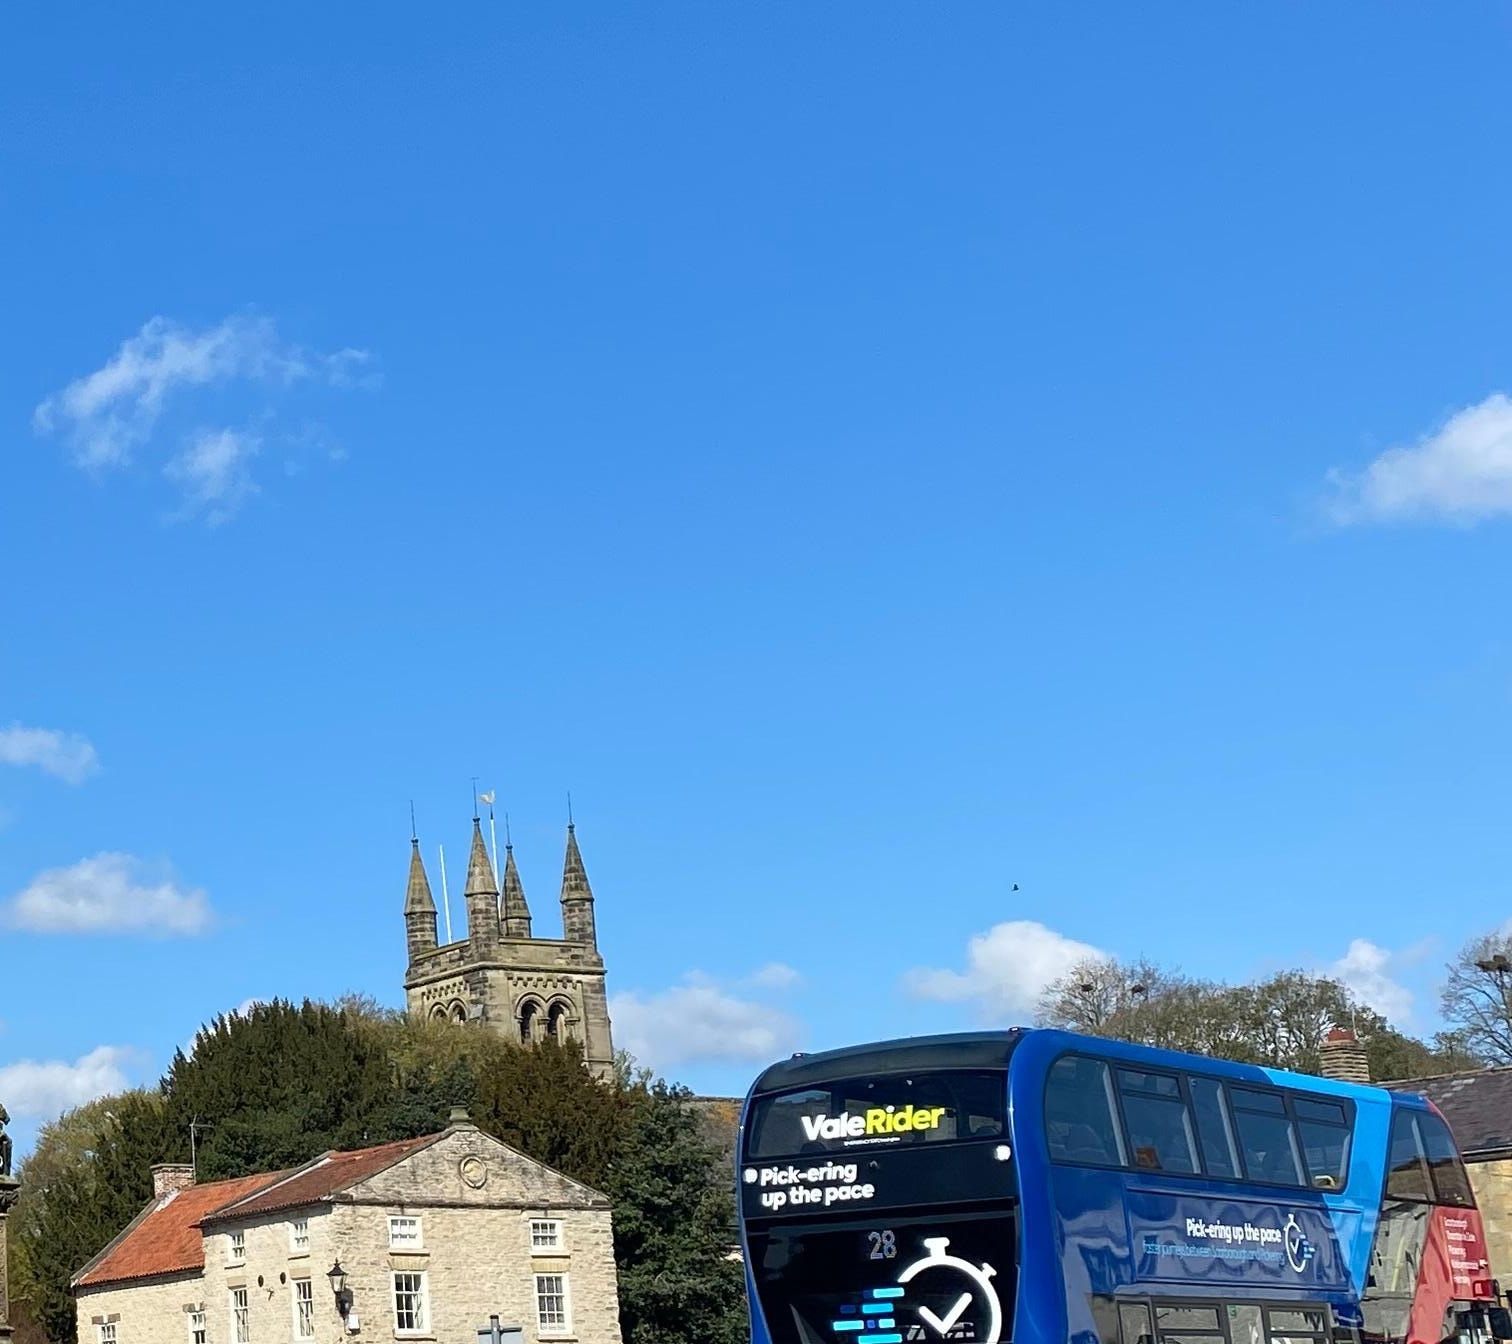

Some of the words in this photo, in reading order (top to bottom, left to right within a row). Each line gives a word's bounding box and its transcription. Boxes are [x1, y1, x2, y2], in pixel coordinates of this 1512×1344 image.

[801, 1104, 946, 1141] ValeRider
[760, 1162, 858, 1187] Pick-ering
[762, 1191, 786, 1210] up
[789, 1185, 822, 1205] the
[825, 1182, 875, 1206] pace
[868, 1230, 896, 1259] 28
[1186, 1218, 1232, 1244] Pick-ering
[1232, 1227, 1245, 1244] up
[1245, 1222, 1260, 1242] the
